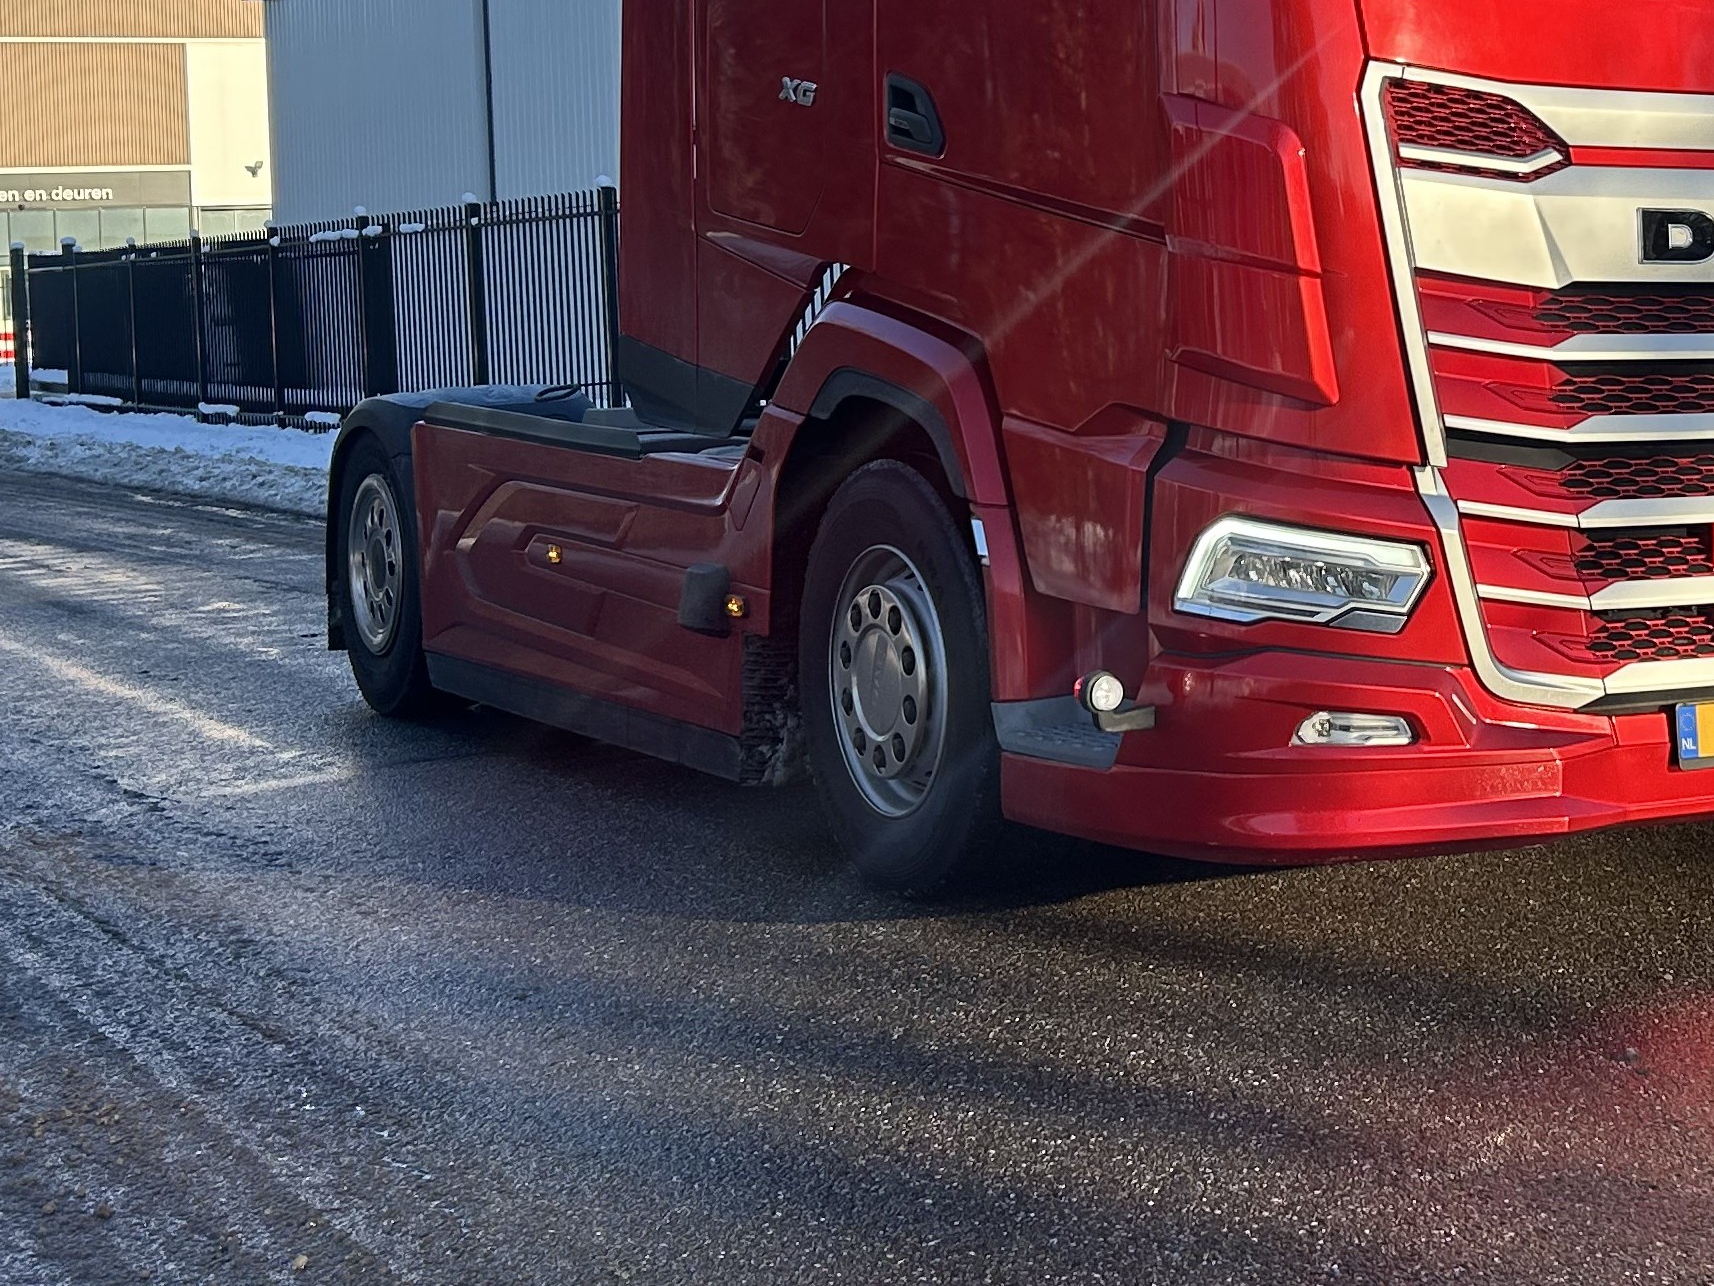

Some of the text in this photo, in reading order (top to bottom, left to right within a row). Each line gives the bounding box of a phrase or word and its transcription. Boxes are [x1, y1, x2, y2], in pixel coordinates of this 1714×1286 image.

[779, 76, 818, 107] XG
[23, 189, 47, 201] en
[51, 185, 113, 201] deuren
[1681, 737, 1697, 751] NL
